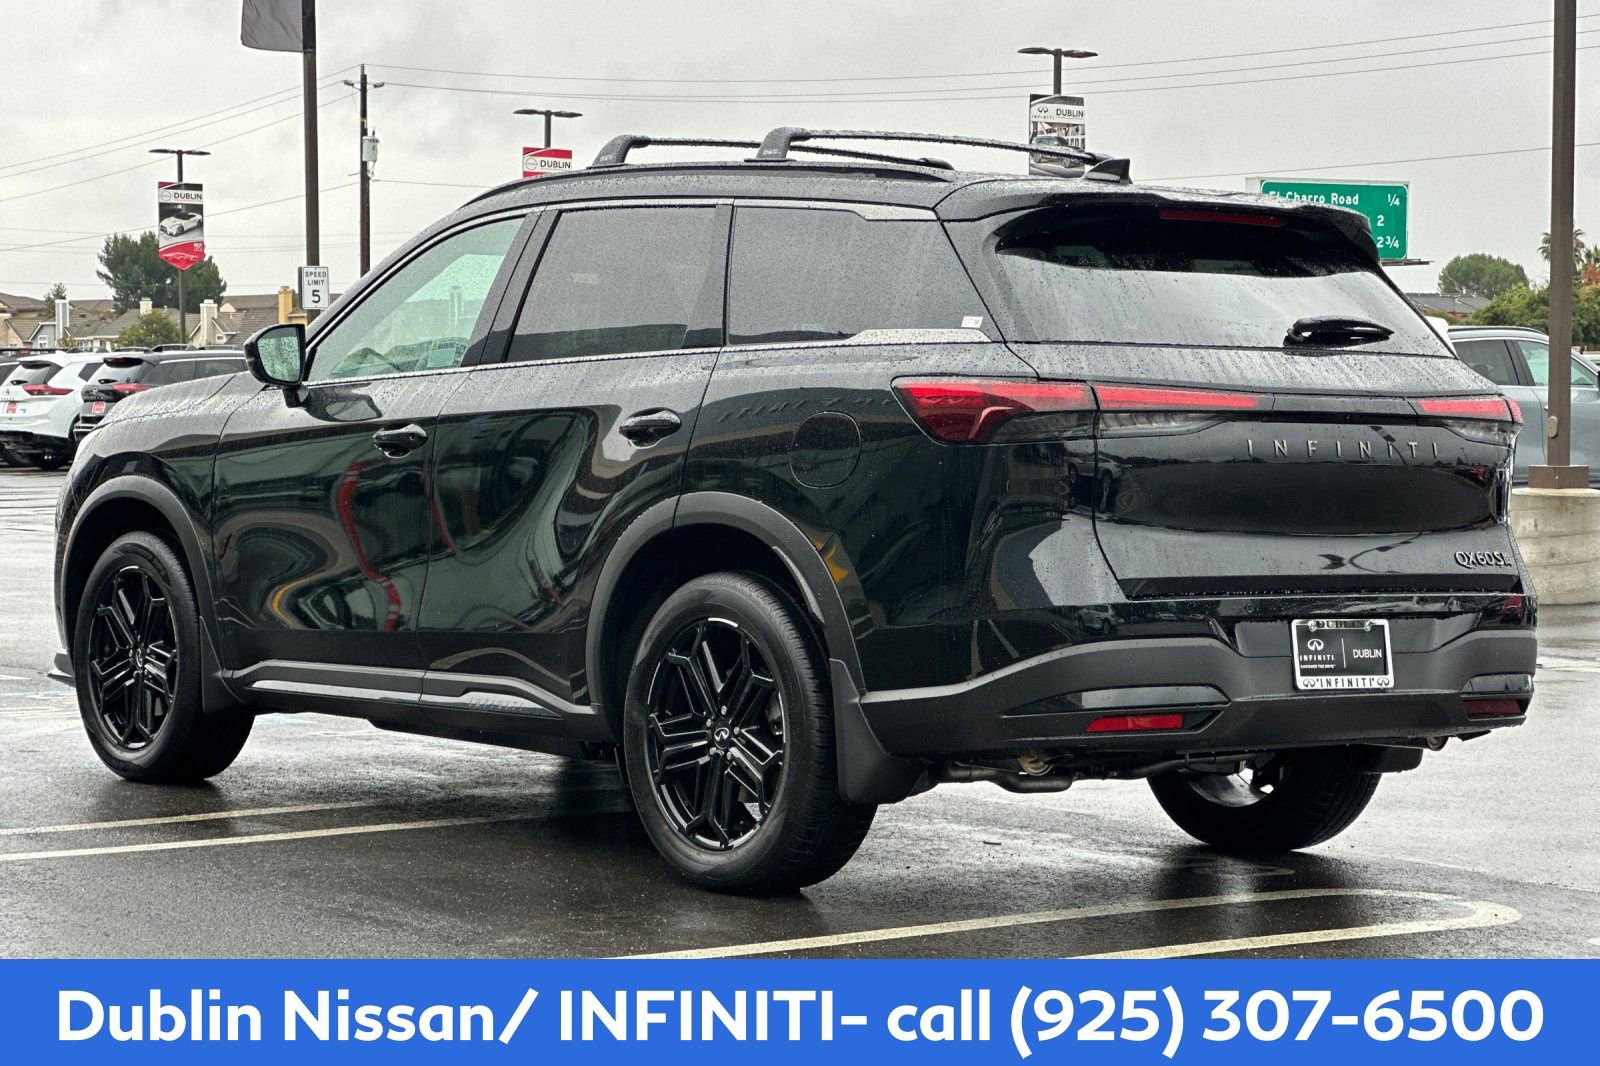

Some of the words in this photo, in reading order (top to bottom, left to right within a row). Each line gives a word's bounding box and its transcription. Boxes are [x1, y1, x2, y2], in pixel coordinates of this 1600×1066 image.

[1056, 108, 1084, 118] DUBLIN
[540, 159, 571, 169] DUBLIN
[173, 191, 202, 200] DUBLIN
[1331, 193, 1360, 205] Road
[1376, 214, 1385, 227] 2
[312, 289, 321, 304] 5
[1247, 439, 1438, 460] INFINITI
[1300, 654, 1335, 662] INFINITI
[1352, 648, 1382, 659] DUBLIN
[1320, 678, 1373, 688] INFINITI
